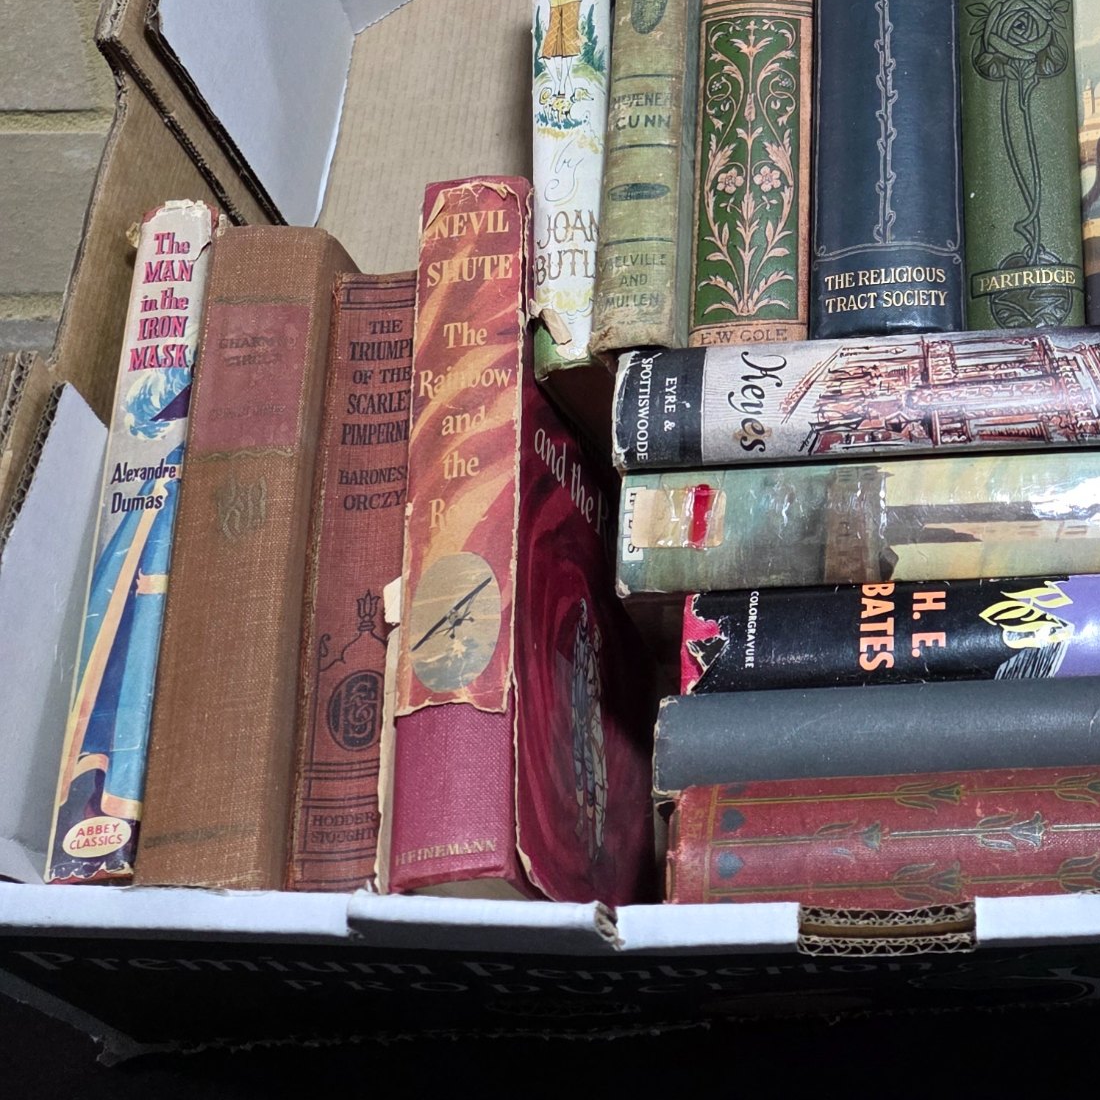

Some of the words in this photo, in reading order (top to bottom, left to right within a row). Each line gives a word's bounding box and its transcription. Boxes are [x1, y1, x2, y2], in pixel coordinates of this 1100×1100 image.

[430, 209, 510, 241] NEVIL
[153, 232, 190, 255] The
[141, 260, 194, 284] MAN
[426, 254, 512, 288] SHUTE
[618, 273, 648, 287] AND
[825, 273, 856, 291] THE
[857, 267, 946, 285] RELIGIOUS
[979, 269, 1076, 292] PARTRIDGE
[139, 294, 160, 313] in
[160, 288, 189, 311] the
[825, 292, 876, 314] TRACT
[882, 290, 948, 308] SOCIETY
[137, 316, 189, 342] IRON
[368, 319, 403, 335] THE
[443, 321, 488, 349] The
[745, 328, 789, 342] COLE
[128, 344, 189, 373] MASK
[352, 370, 374, 386] OF
[379, 368, 412, 385] THE
[418, 366, 512, 399] Rainbow
[663, 377, 678, 414] EYRE
[728, 351, 787, 454] Keyes
[635, 357, 654, 461] SPOTTISWOODE
[441, 409, 486, 437] and
[663, 421, 674, 432] &
[110, 457, 177, 485] Alexandre
[444, 451, 480, 479] the
[533, 427, 567, 488] and
[570, 458, 595, 525] the
[111, 493, 163, 514] Dumas
[343, 489, 407, 511] ORCZY
[744, 590, 760, 669] COLORGRAVURE
[859, 582, 895, 672] BATES
[75, 822, 121, 838] ABBEY
[312, 811, 377, 827] HODDER
[69, 833, 123, 850] CLASSICS
[395, 839, 497, 867] HEINEMANN
[8, 950, 438, 975] Premium
